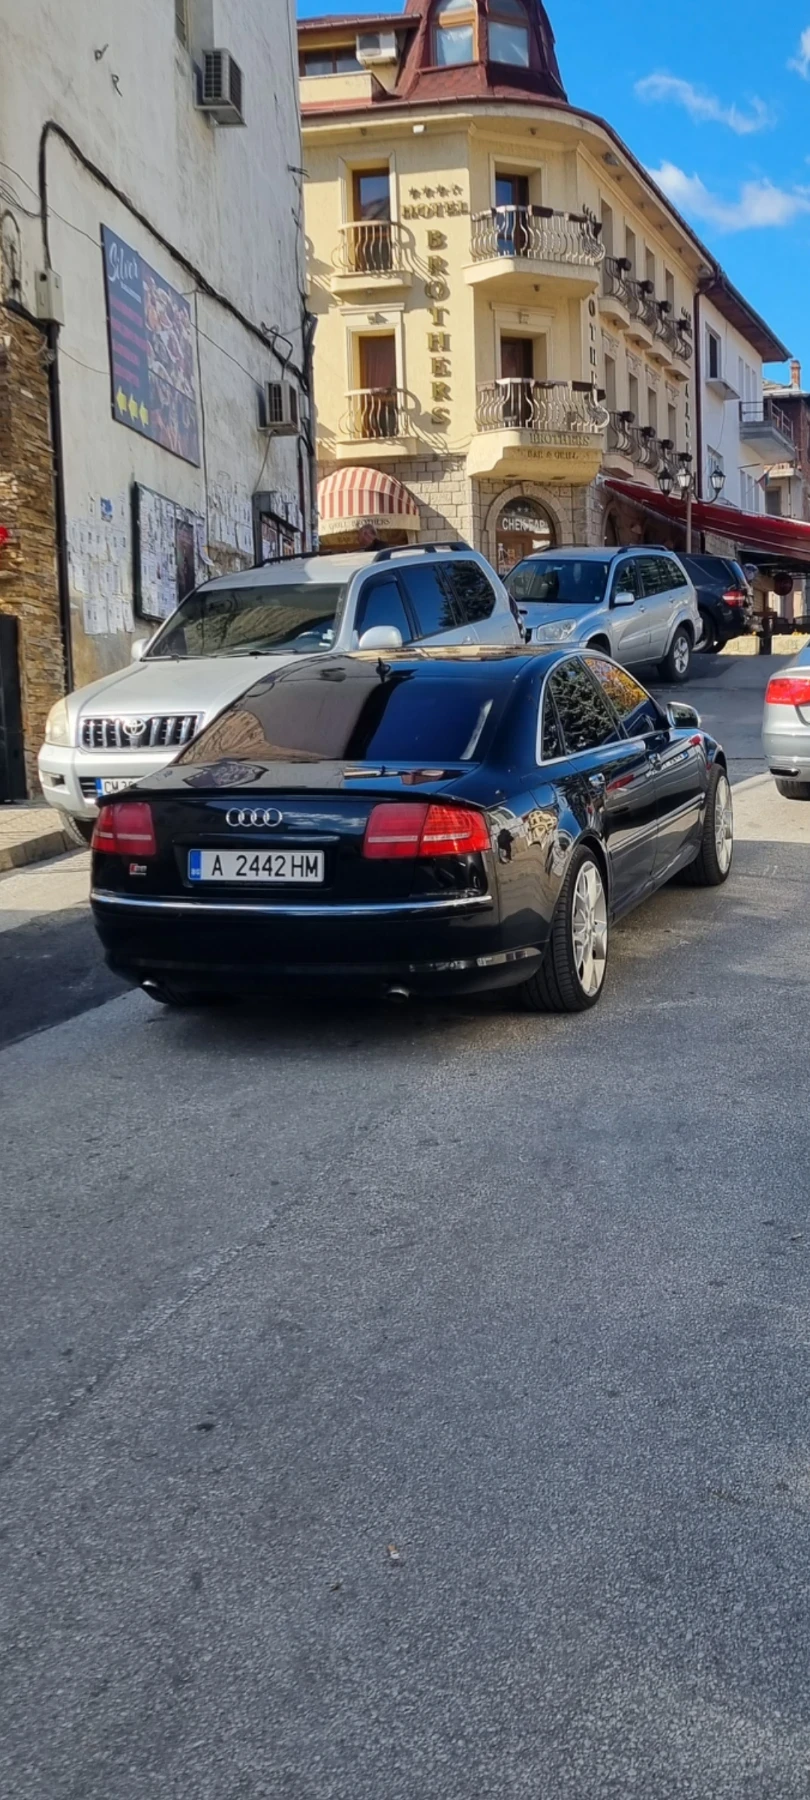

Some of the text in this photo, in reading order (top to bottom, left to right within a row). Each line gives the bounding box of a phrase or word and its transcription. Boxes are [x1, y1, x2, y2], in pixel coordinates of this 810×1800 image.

[402, 202, 468, 219] HOTEL
[108, 242, 138, 281] Silver
[425, 229, 451, 425] BROTHERS
[530, 433, 590, 446] BROTHERS
[211, 854, 223, 876] A
[235, 855, 286, 877] 2442
[291, 855, 318, 878] HM
